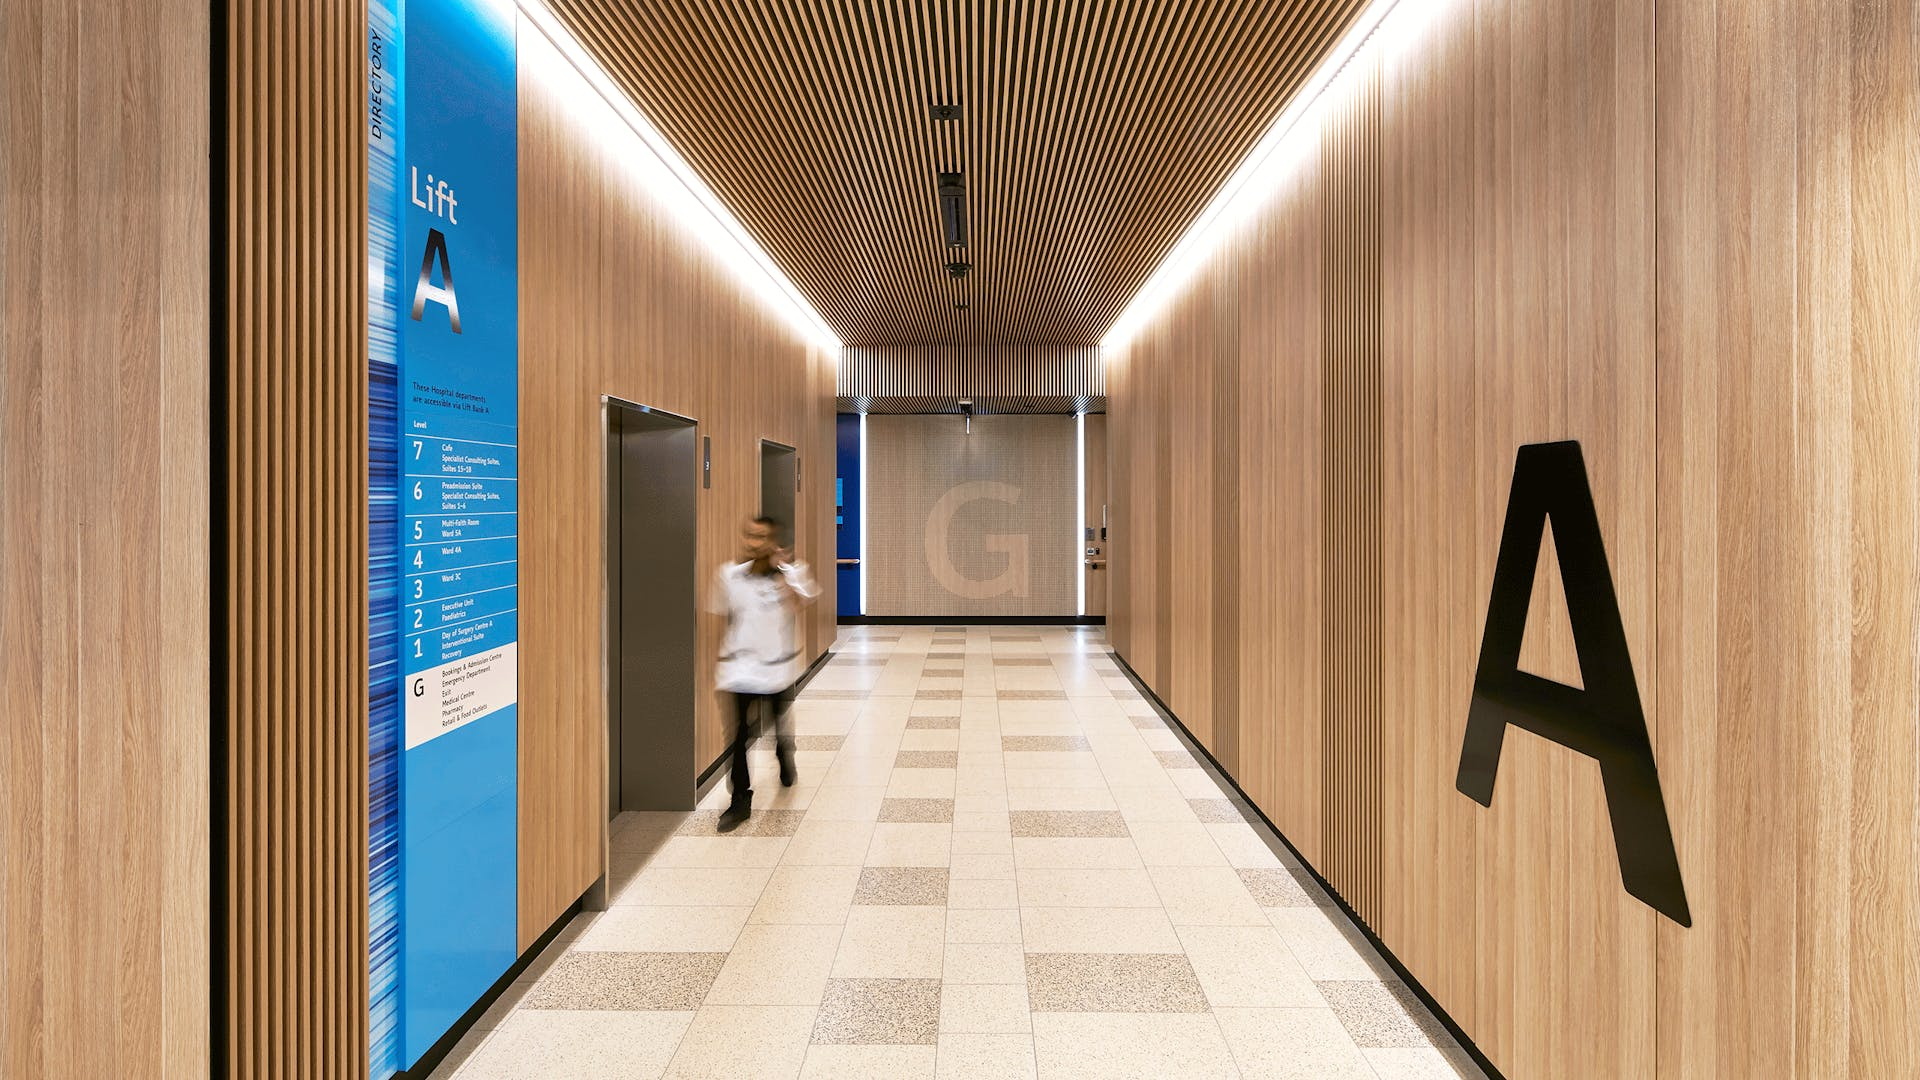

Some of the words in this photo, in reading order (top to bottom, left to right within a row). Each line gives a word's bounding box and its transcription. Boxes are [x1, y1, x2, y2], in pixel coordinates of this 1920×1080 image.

[371, 28, 383, 140] DIRECTORY
[411, 166, 457, 225] Lift
[411, 228, 462, 334] A
[413, 382, 430, 392] These
[432, 385, 454, 397] Hospital
[456, 392, 486, 403] departments
[424, 398, 451, 407] accessible
[462, 403, 471, 411] Lift
[414, 420, 427, 429] Level
[413, 441, 422, 460] 7
[442, 454, 464, 463] Specialist
[465, 456, 486, 466] Consulting
[414, 481, 422, 500] 6
[442, 482, 471, 490] Preadmission
[442, 492, 464, 501] Specialist
[465, 492, 486, 502] Consulting
[414, 521, 422, 540] 5
[924, 480, 1029, 599] G
[414, 550, 423, 568] 4
[414, 579, 422, 598] 3
[442, 602, 463, 611] Executive
[414, 608, 422, 628] 2
[442, 611, 466, 622] Paediatrics
[414, 638, 422, 658] 1
[442, 636, 472, 649] Interventional
[442, 650, 462, 660] Recovery
[442, 667, 462, 678] Bookings
[489, 653, 502, 662] Centre
[442, 676, 465, 688] Emergency
[466, 666, 490, 678] Department
[1456, 440, 1692, 928] A
[414, 678, 424, 697] G
[442, 690, 451, 698] Exit
[442, 694, 460, 707] Medical
[460, 690, 474, 700] Centre
[442, 704, 463, 717] Pharmacy
[442, 716, 456, 728] Retail
[461, 711, 471, 719] Food
[472, 704, 488, 714] Outlets
